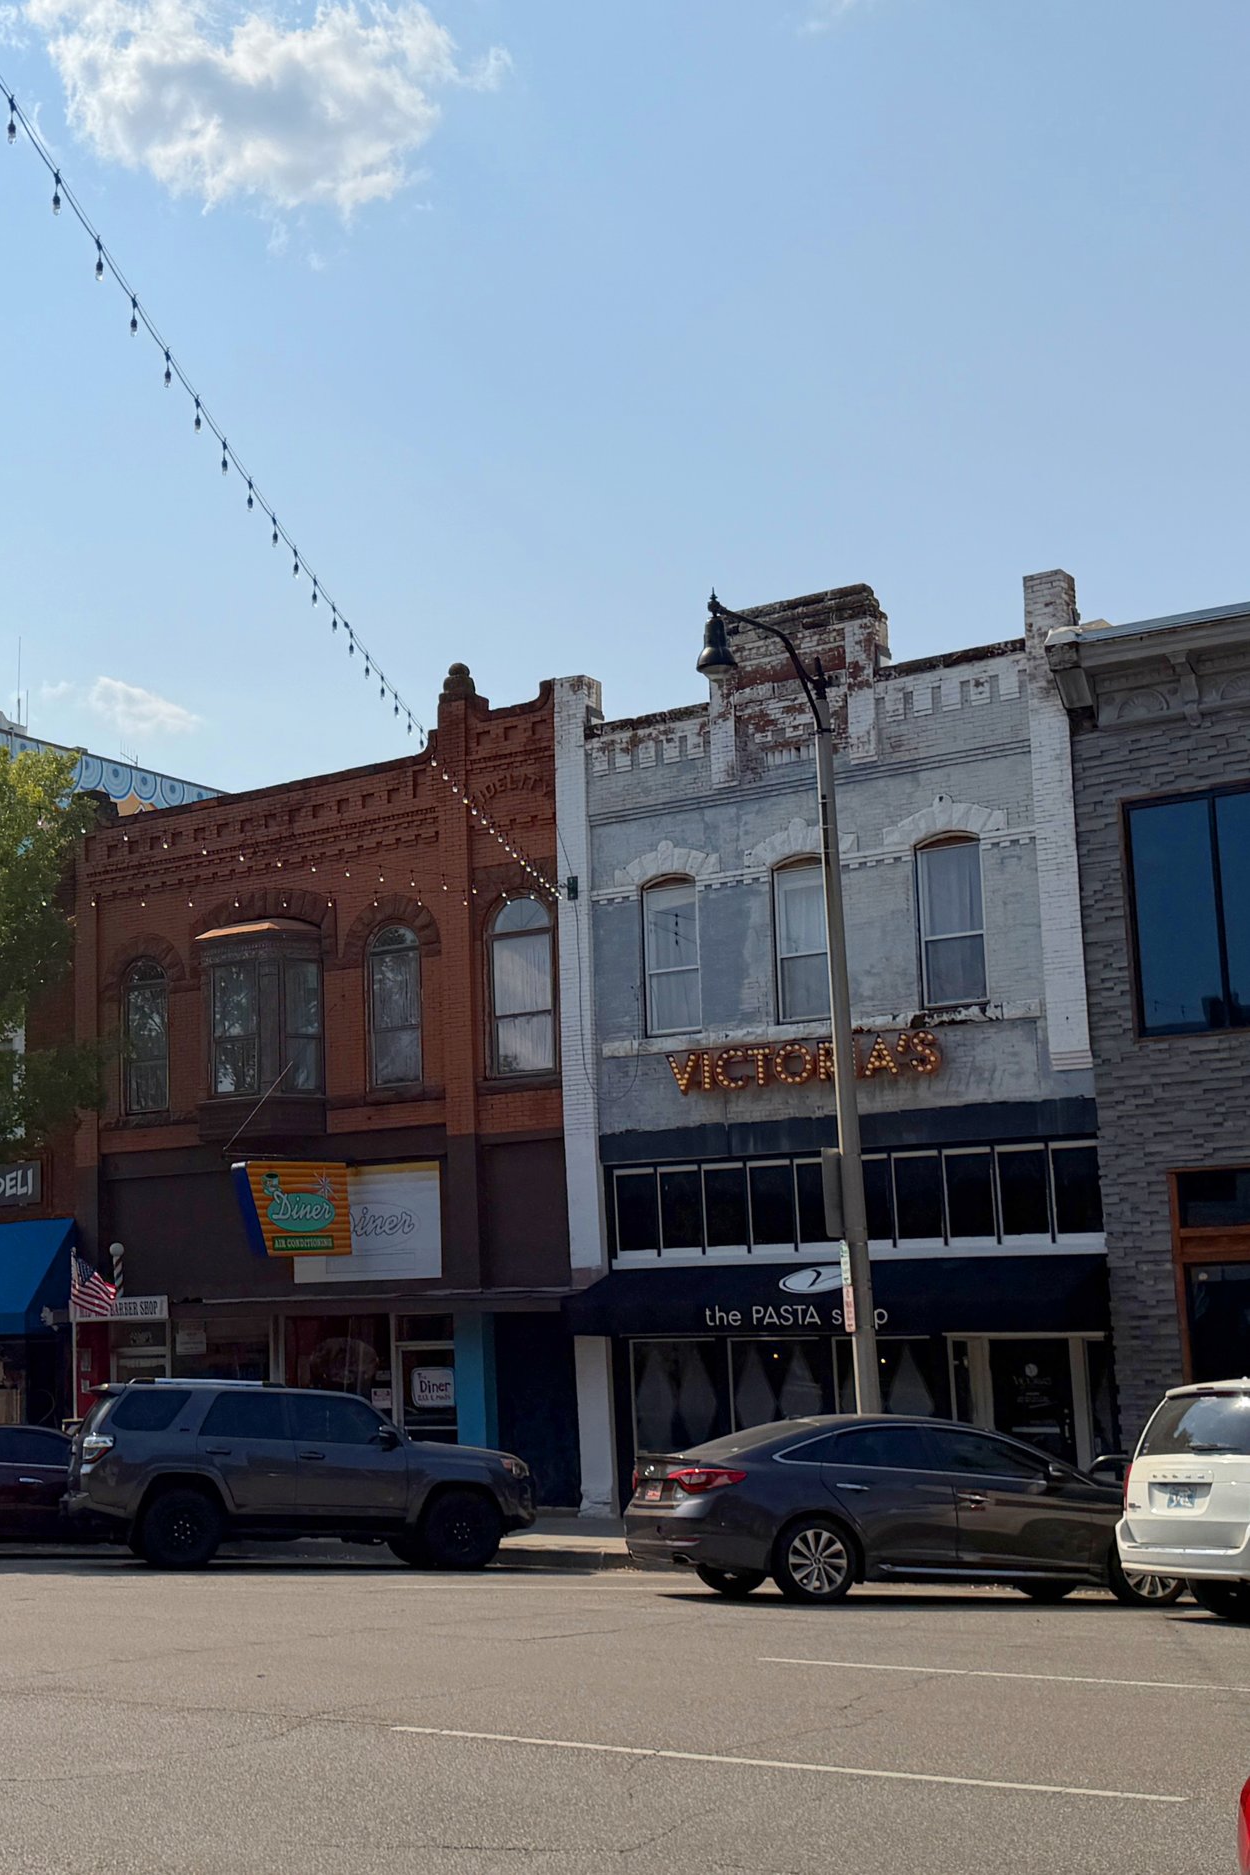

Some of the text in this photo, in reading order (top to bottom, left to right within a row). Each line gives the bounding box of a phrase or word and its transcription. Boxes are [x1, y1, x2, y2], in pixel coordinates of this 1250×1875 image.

[272, 1191, 333, 1221] Diner
[349, 1206, 415, 1237] iner
[140, 1301, 158, 1315] SHOP
[705, 1304, 742, 1326] the
[752, 1304, 822, 1326] PASTA
[831, 1308, 888, 1330] sp
[420, 1380, 451, 1394] Diner
